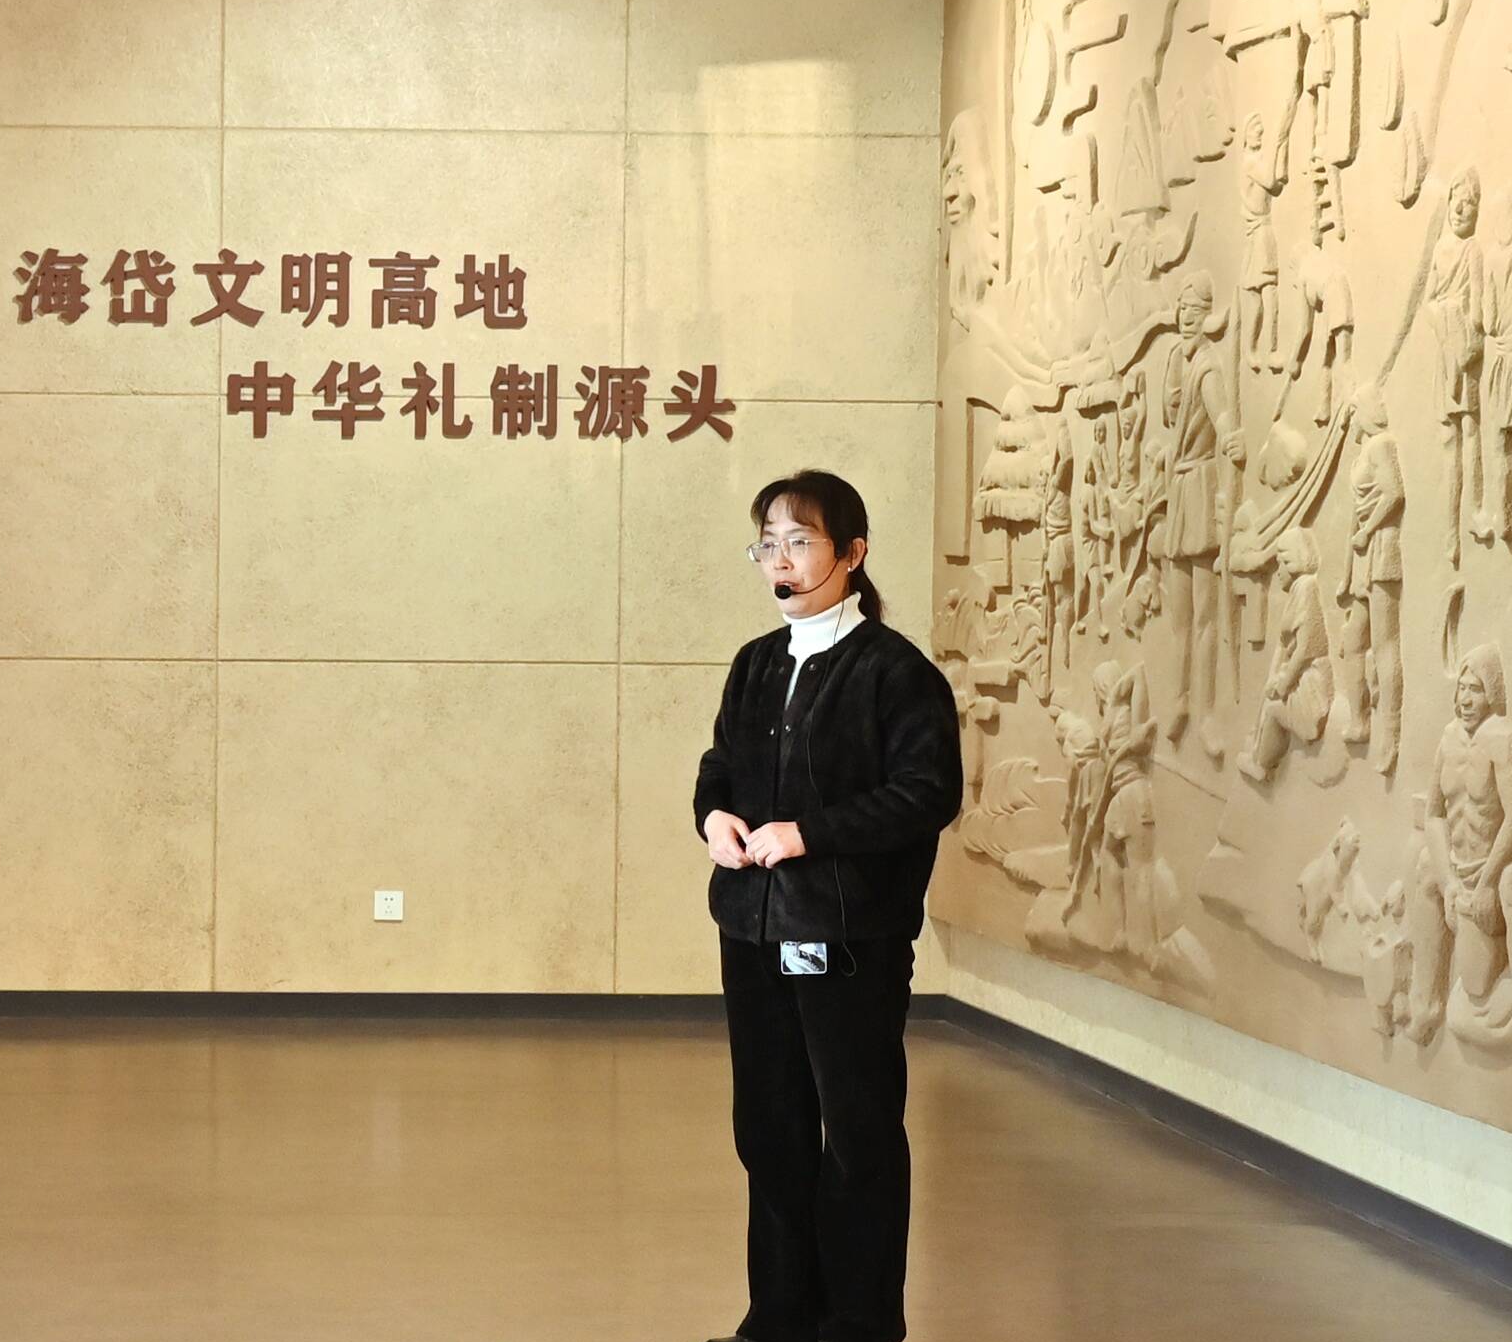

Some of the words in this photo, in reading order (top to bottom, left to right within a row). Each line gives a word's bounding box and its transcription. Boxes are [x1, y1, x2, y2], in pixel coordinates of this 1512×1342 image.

[13, 248, 528, 330] 海岱文明高地
[225, 360, 736, 442] 中华礼制源头
